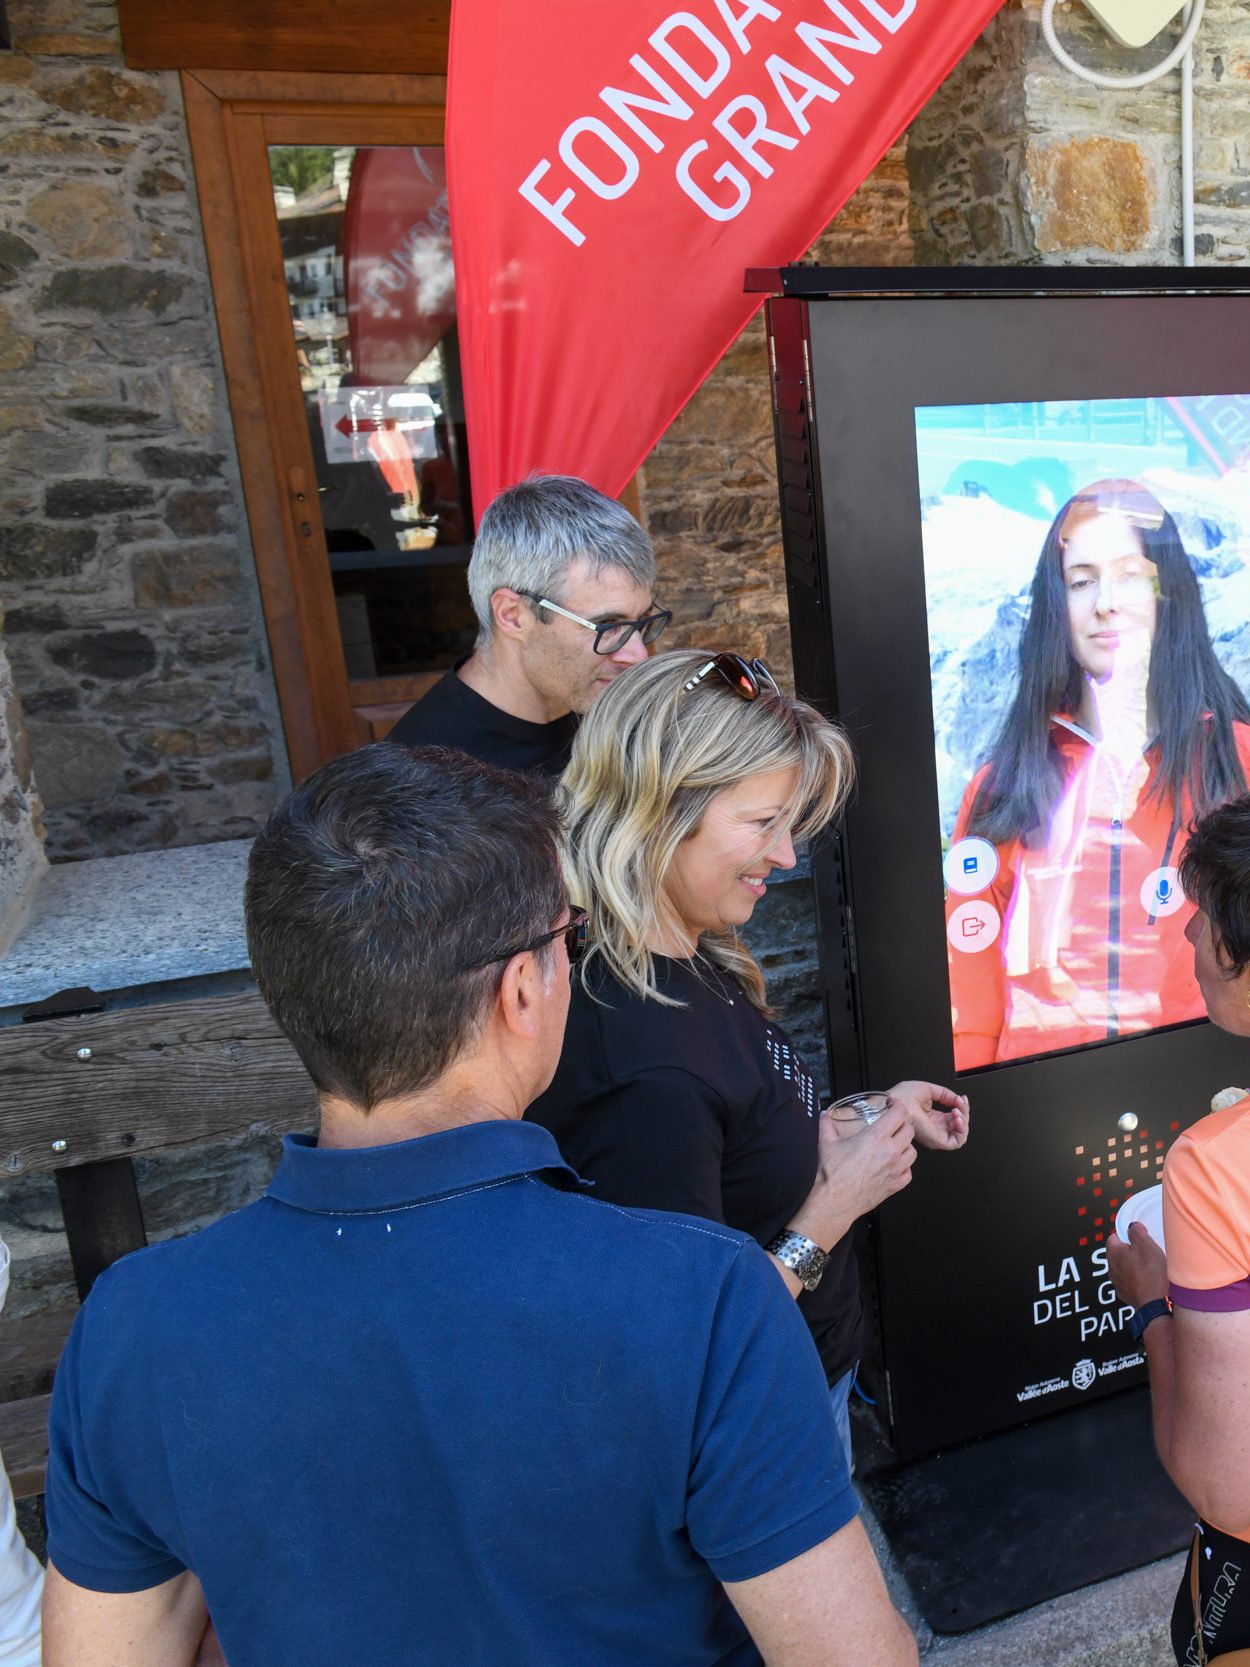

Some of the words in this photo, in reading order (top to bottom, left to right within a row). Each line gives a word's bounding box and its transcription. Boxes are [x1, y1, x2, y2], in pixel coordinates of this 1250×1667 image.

[518, 0, 782, 247] FONDA
[1038, 1256, 1081, 1292] LA
[1033, 1289, 1090, 1325] DEL
[1098, 1363, 1117, 1376] Valle
